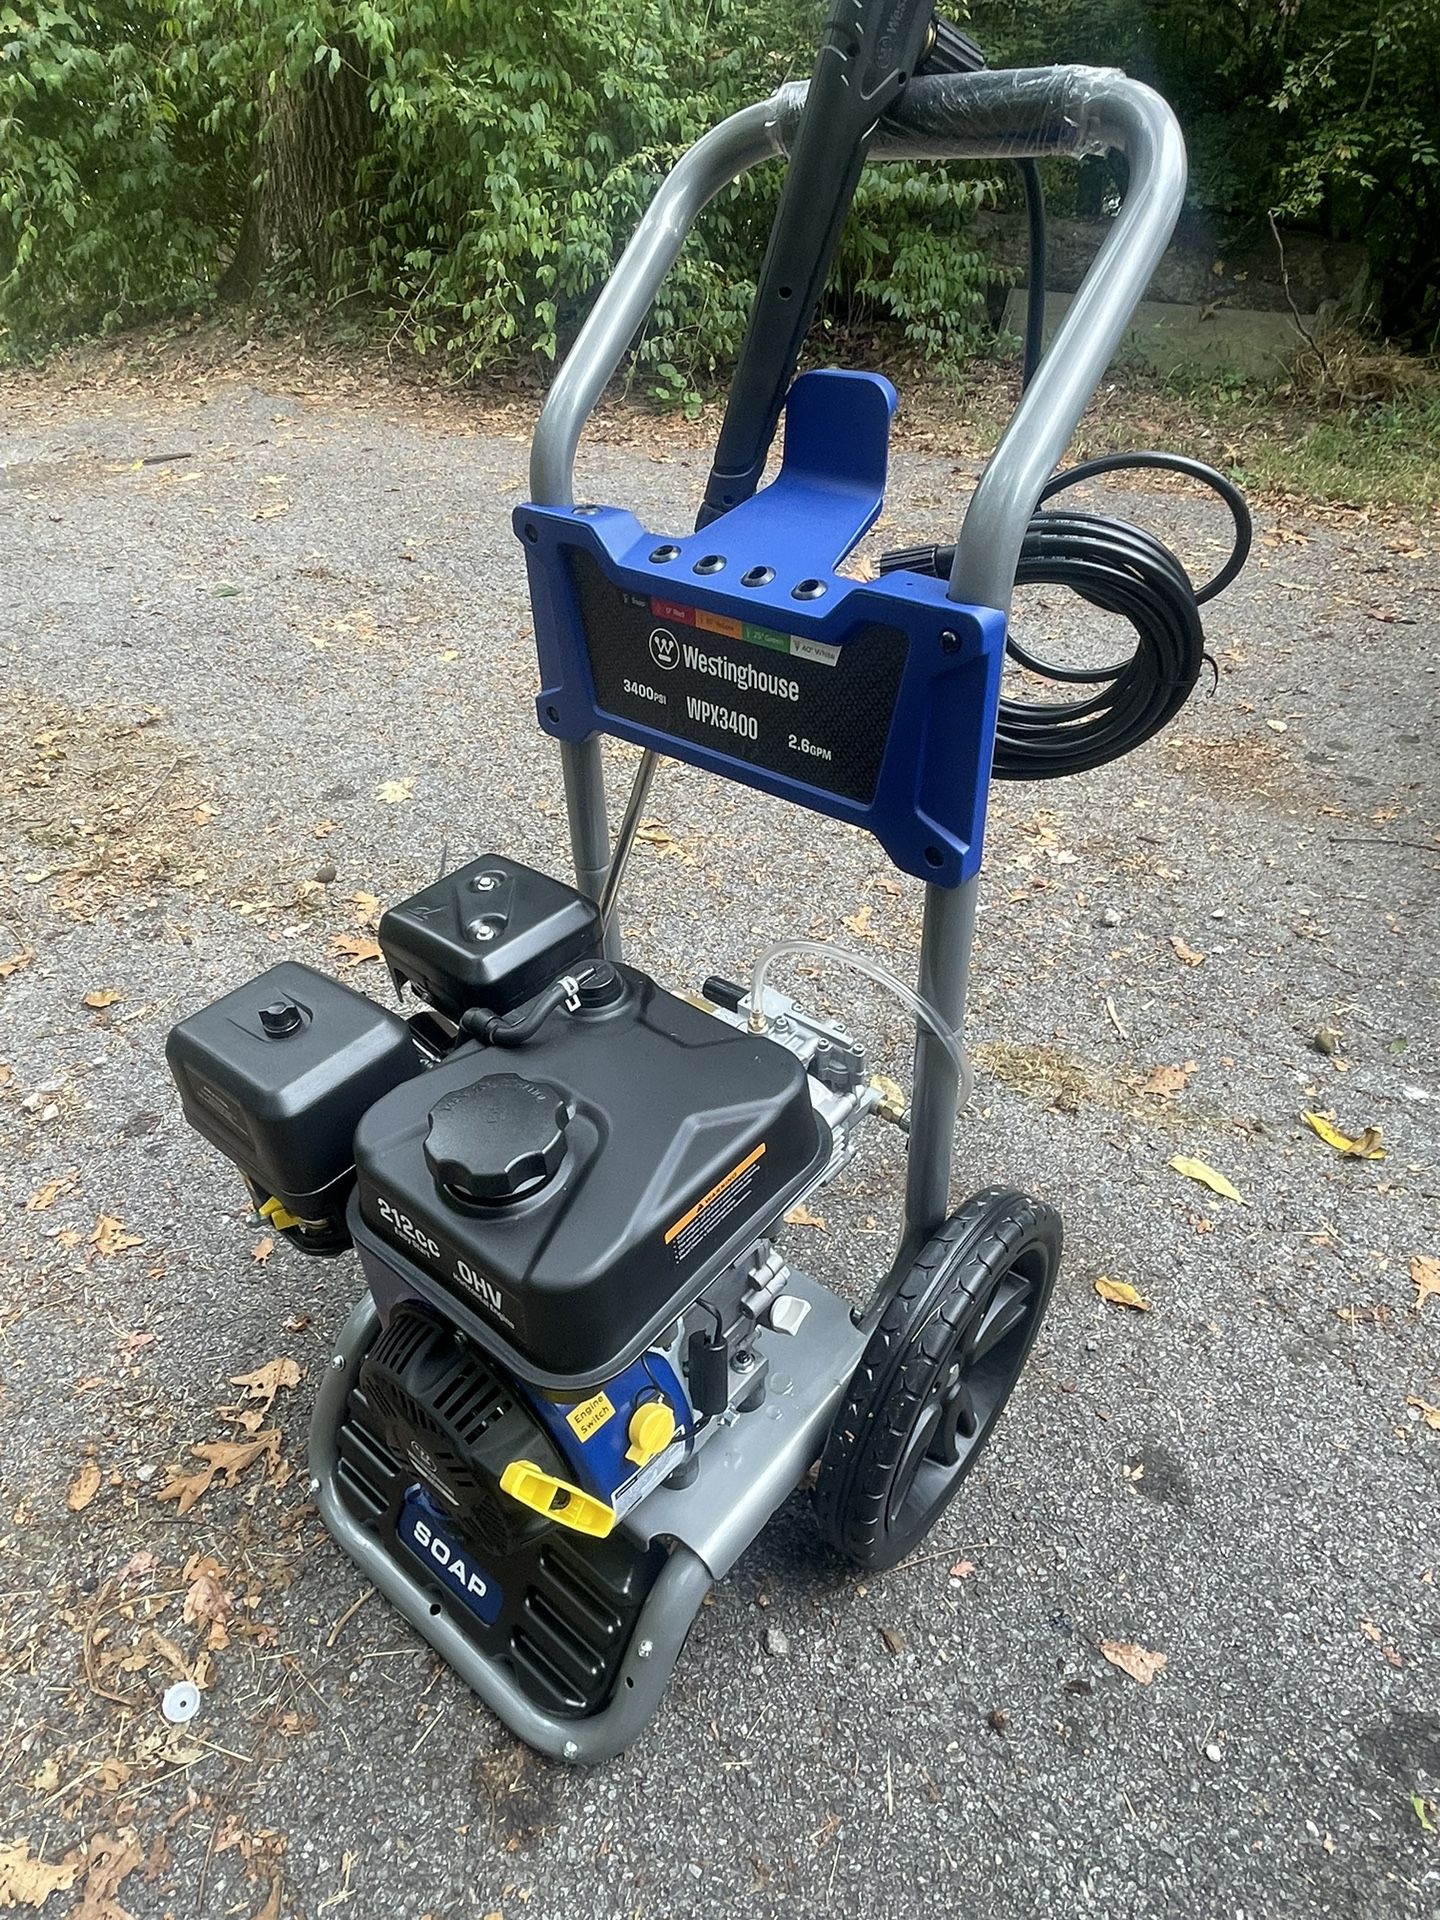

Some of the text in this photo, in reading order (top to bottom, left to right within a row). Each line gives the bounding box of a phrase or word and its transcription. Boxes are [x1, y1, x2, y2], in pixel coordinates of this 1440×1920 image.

[682, 643, 800, 702] Westinghouse
[686, 695, 759, 740] WPX3400
[457, 1260, 502, 1311] OHV
[573, 1395, 604, 1424] Engine
[580, 1405, 610, 1435] Switch
[413, 1520, 487, 1598] SOAP
